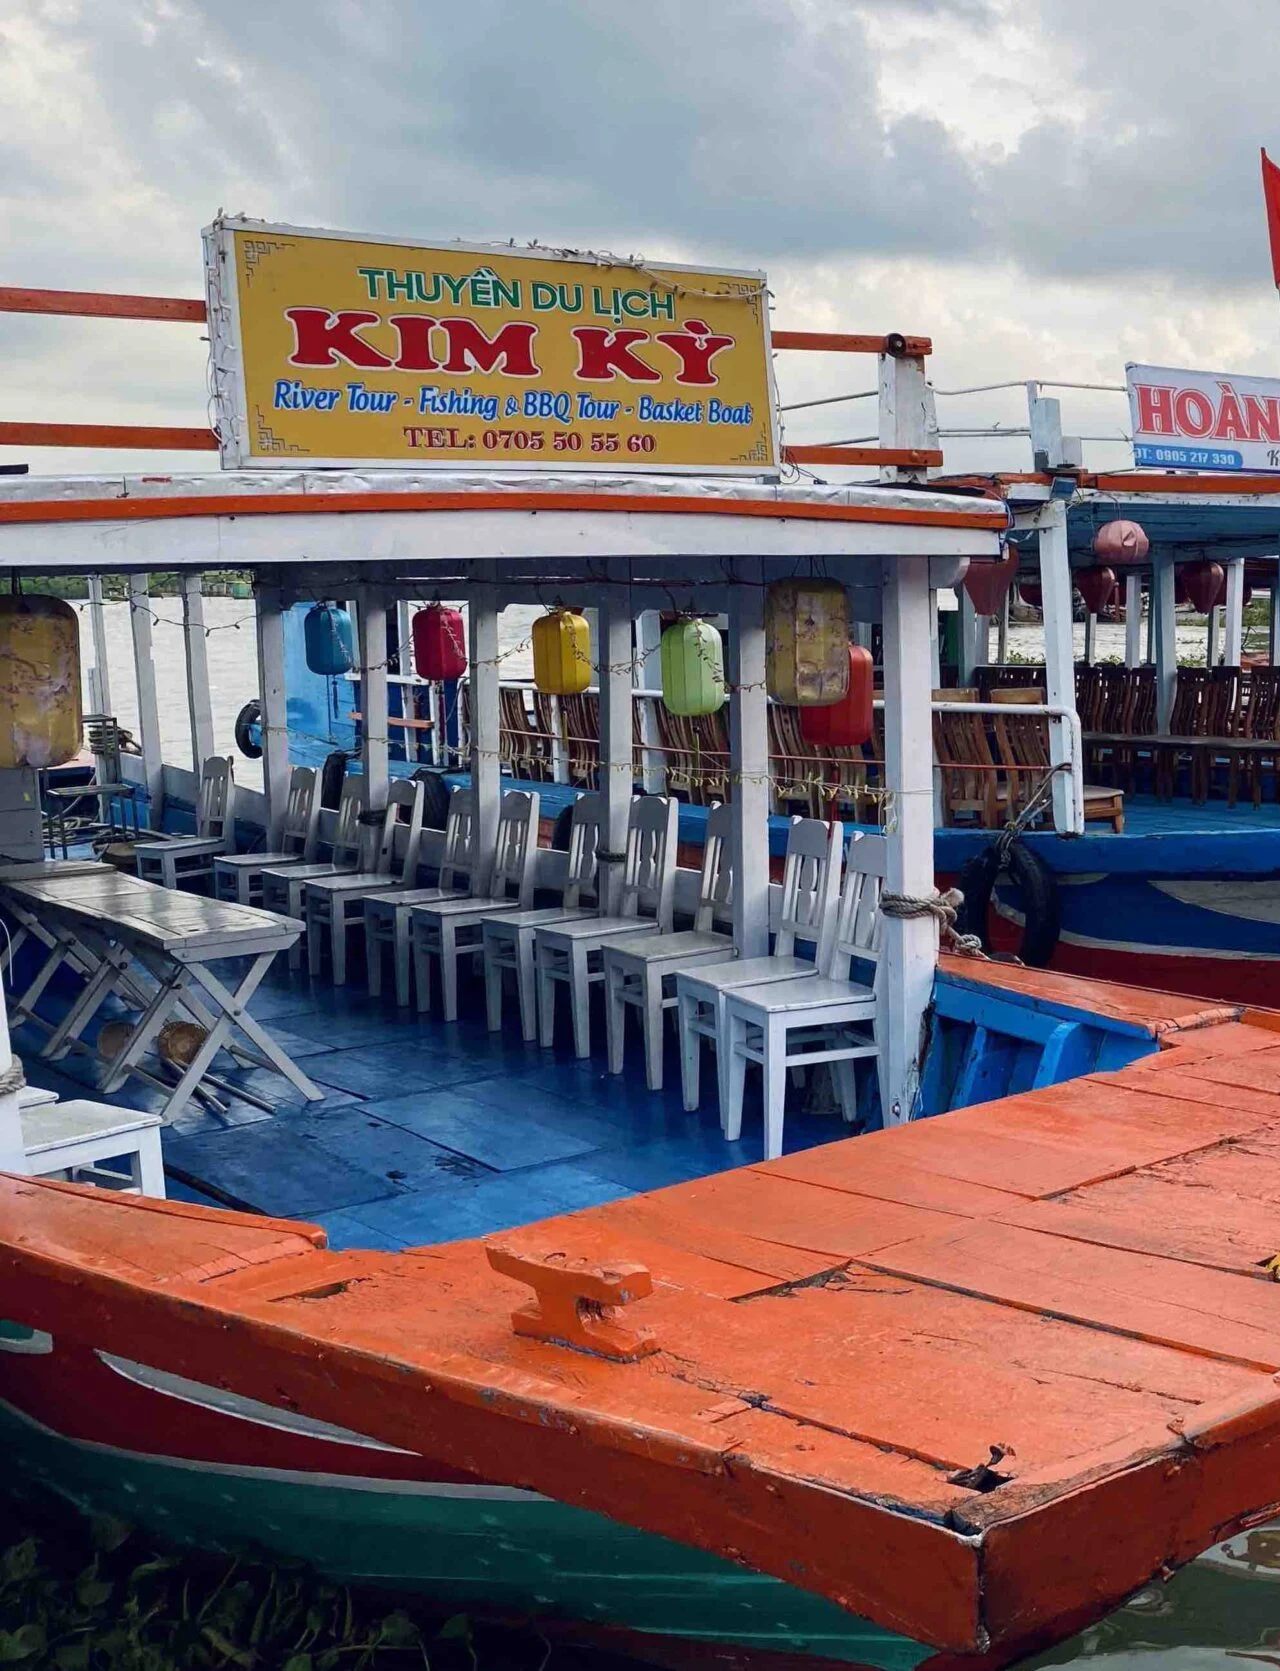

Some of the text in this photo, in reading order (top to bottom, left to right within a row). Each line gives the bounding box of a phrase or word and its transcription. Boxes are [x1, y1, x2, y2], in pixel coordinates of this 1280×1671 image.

[357, 266, 675, 324] THUYỀN DU LỊCH
[284, 306, 541, 378] KIM
[274, 378, 342, 411] River
[347, 382, 400, 413] Tour
[419, 385, 499, 421] Fishing
[504, 395, 520, 417] &
[523, 390, 573, 425] BBQ
[576, 392, 621, 420] Tour
[638, 395, 703, 423] Basket
[707, 398, 753, 425] Boat
[403, 426, 657, 454] TEL: 0705 50 55 60
[1156, 448, 1187, 462] 0905
[1190, 451, 1207, 464] 217
[1212, 453, 1235, 465] 330
